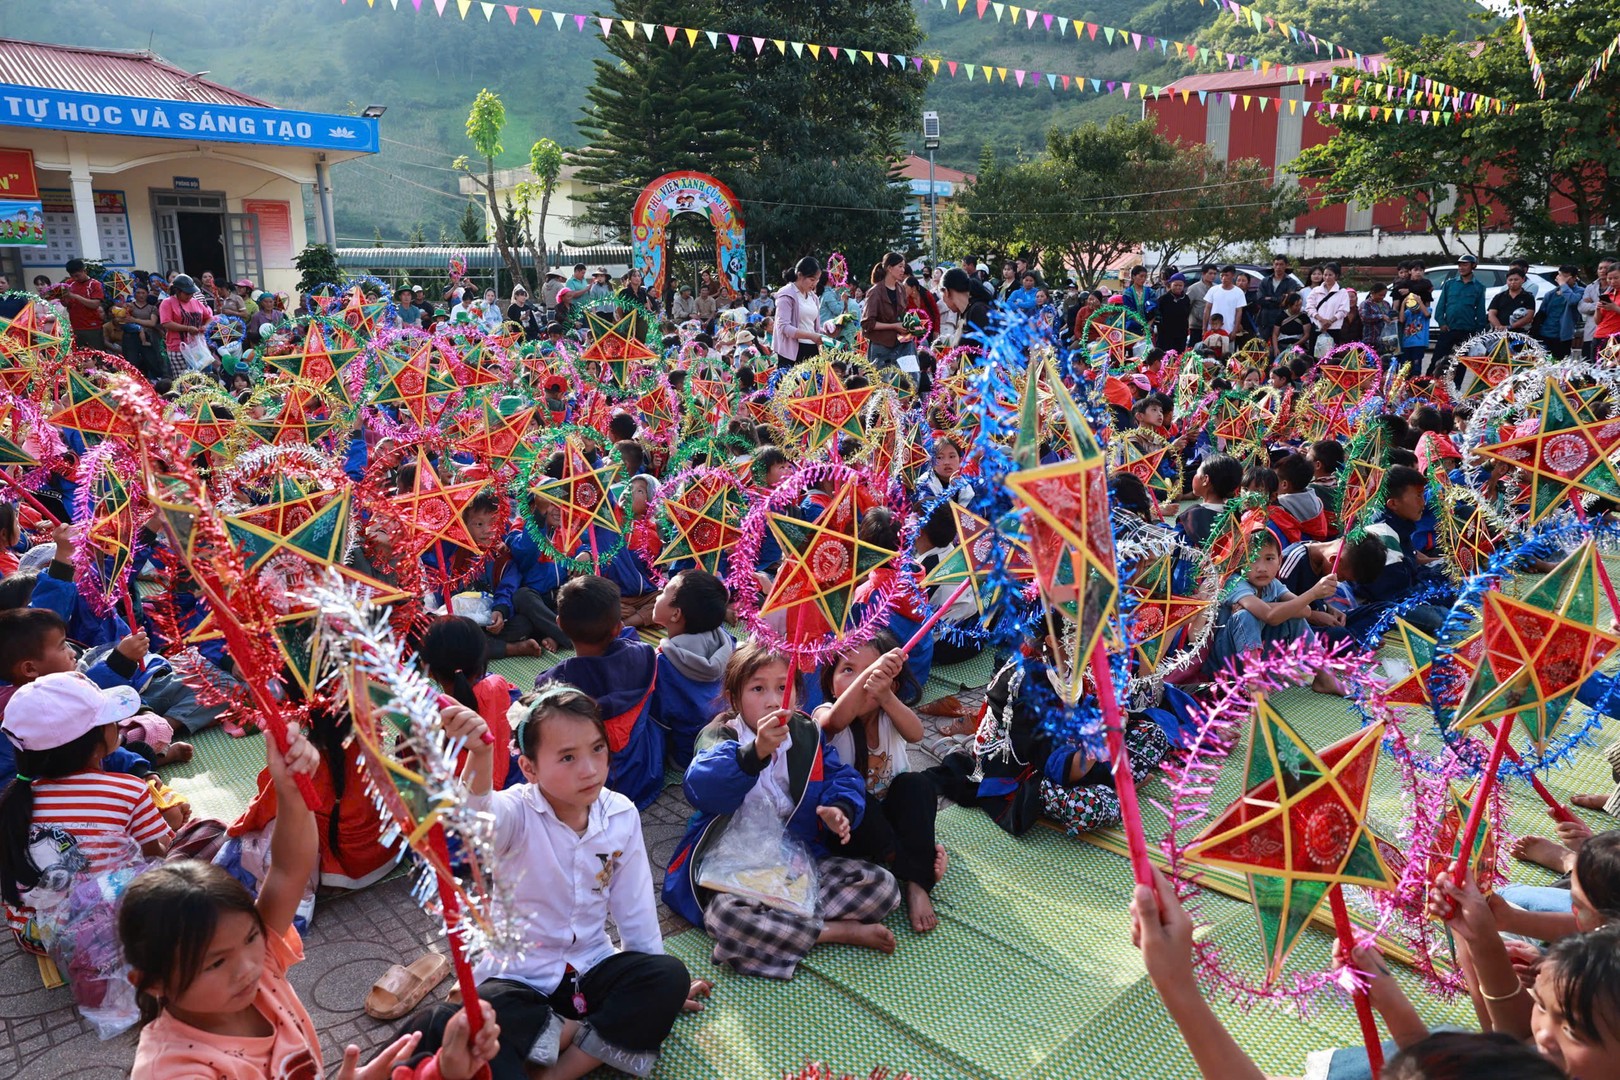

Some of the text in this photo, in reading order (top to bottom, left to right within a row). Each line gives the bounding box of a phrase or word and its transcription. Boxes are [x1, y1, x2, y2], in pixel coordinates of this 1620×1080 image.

[4, 96, 312, 141] TỰ HỌC VÀ SÁNG TẠO
[681, 178, 705, 191] XANH
[719, 200, 730, 215] EM
